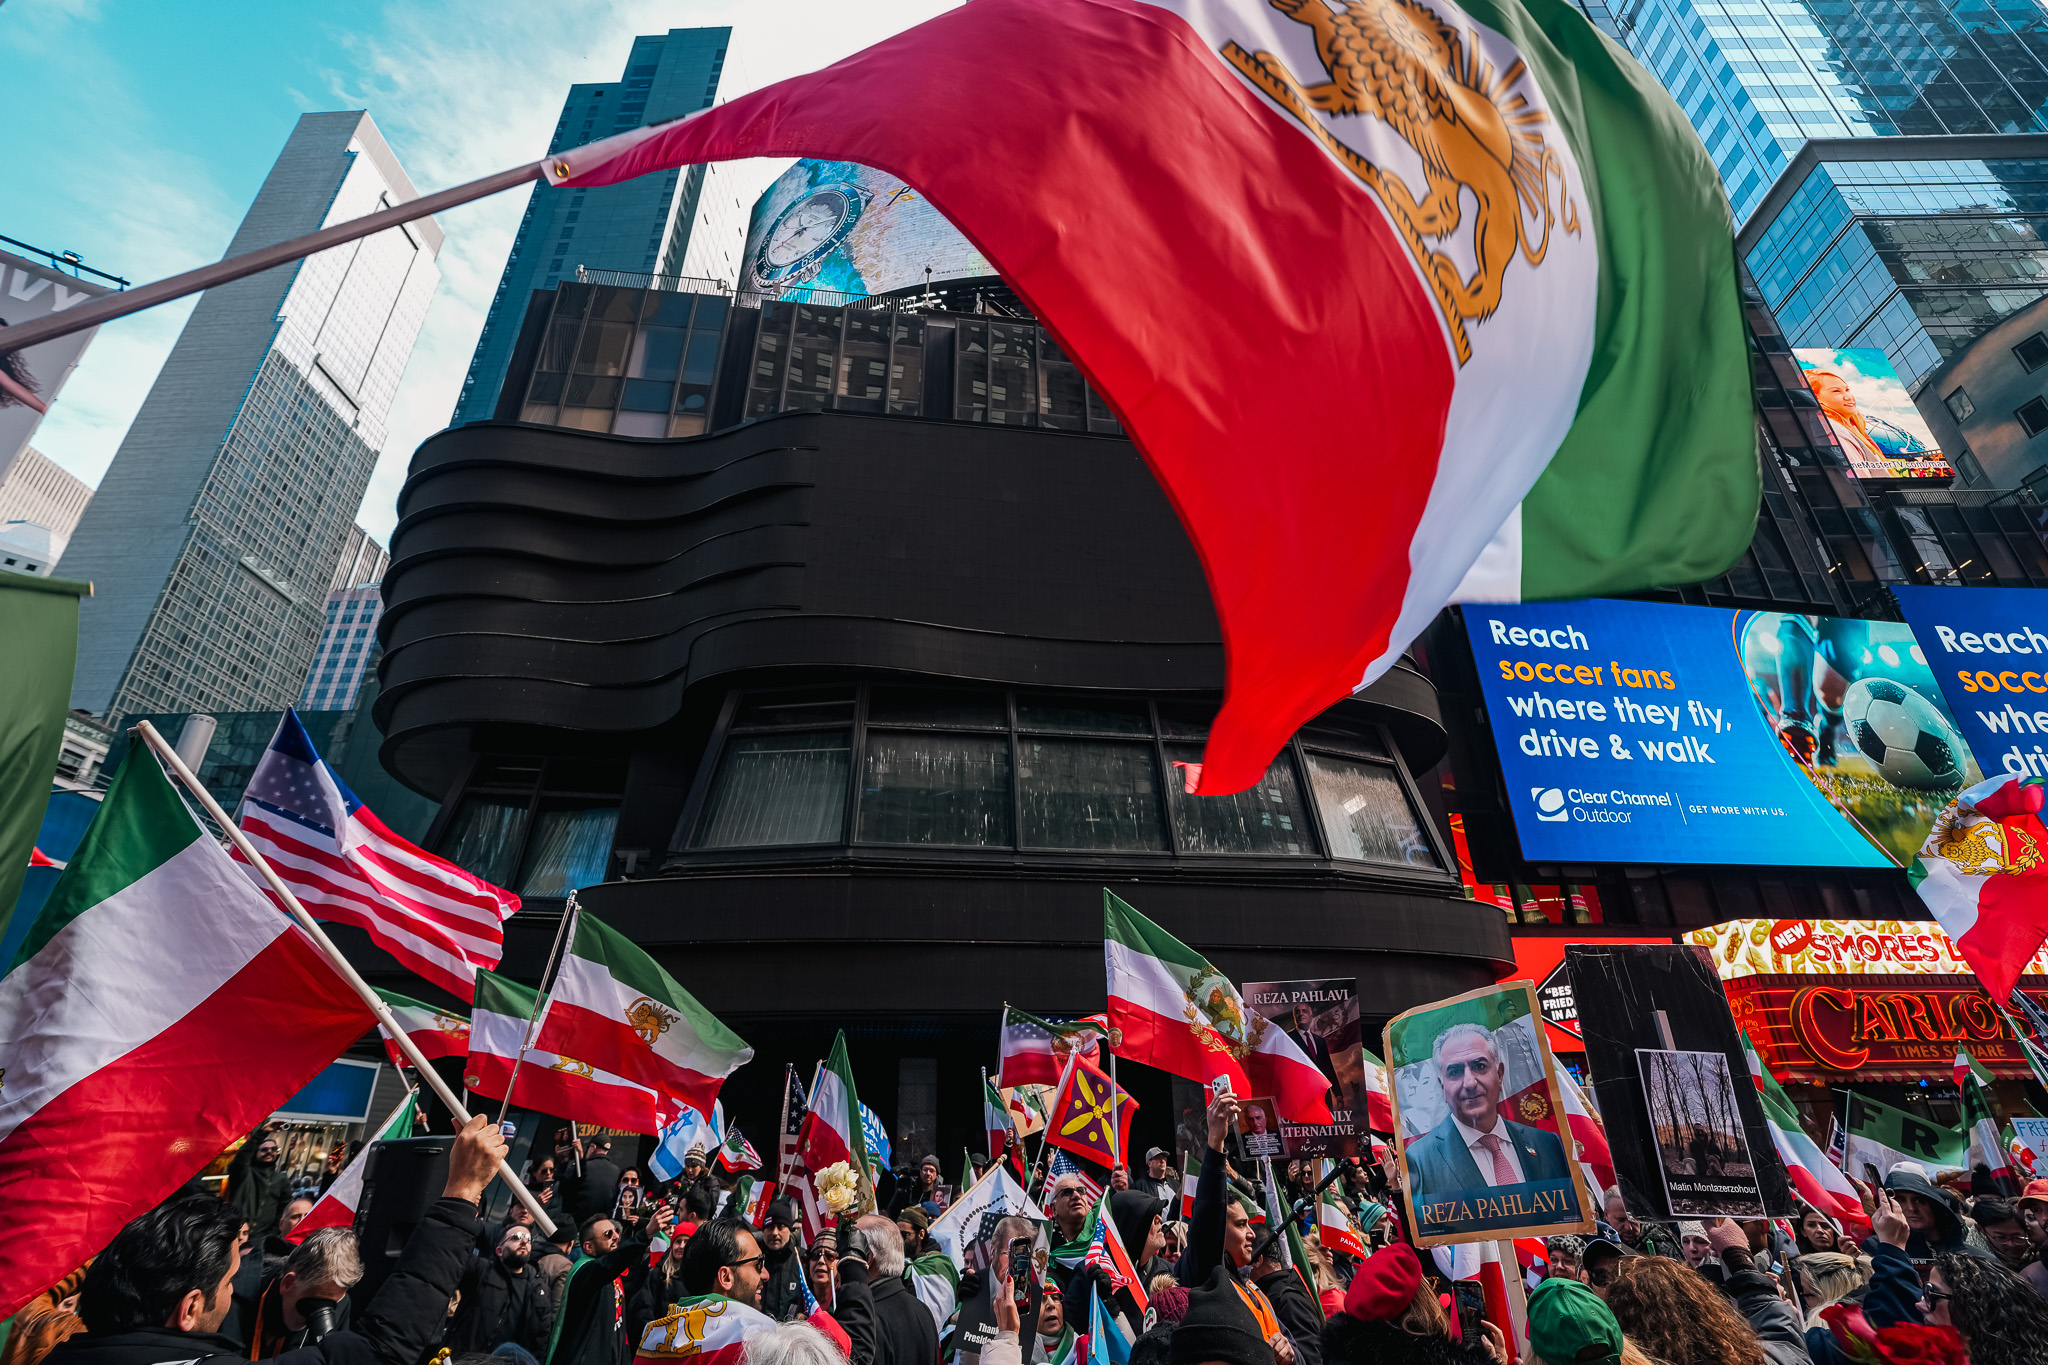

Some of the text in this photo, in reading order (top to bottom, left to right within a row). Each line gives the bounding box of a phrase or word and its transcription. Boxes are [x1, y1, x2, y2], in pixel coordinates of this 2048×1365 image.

[0, 262, 91, 312] VY
[1851, 461, 1947, 469] neMasterTV.com/max
[1488, 619, 1590, 650] Reach
[1934, 625, 2048, 654] Reach
[1499, 660, 1676, 690] soccer fans
[1957, 670, 2048, 694] socc
[1507, 691, 1732, 734] where they fly,
[1975, 703, 2048, 734] whe
[1519, 728, 1717, 764] drive & walk
[2002, 745, 2048, 777] dri
[1567, 788, 1673, 806] Clear Channel
[1572, 806, 1633, 824] Outdoor
[1688, 804, 1789, 817] GET MORE WITH US.
[1773, 922, 1807, 950] NEW
[1253, 988, 1349, 1005] REZA PAHLAVI
[1542, 997, 1574, 1011] FRIED
[1550, 1010, 1564, 1021] IN
[1790, 986, 2038, 1070] CARLOS
[1891, 1044, 1940, 1058] TIMES
[1330, 1110, 1353, 1122] NLY
[1280, 1124, 1355, 1138] LTERNATIVE
[1669, 1181, 1757, 1194] Matin Montazerzohour
[1421, 1189, 1570, 1225] REZA PAHLAVI
